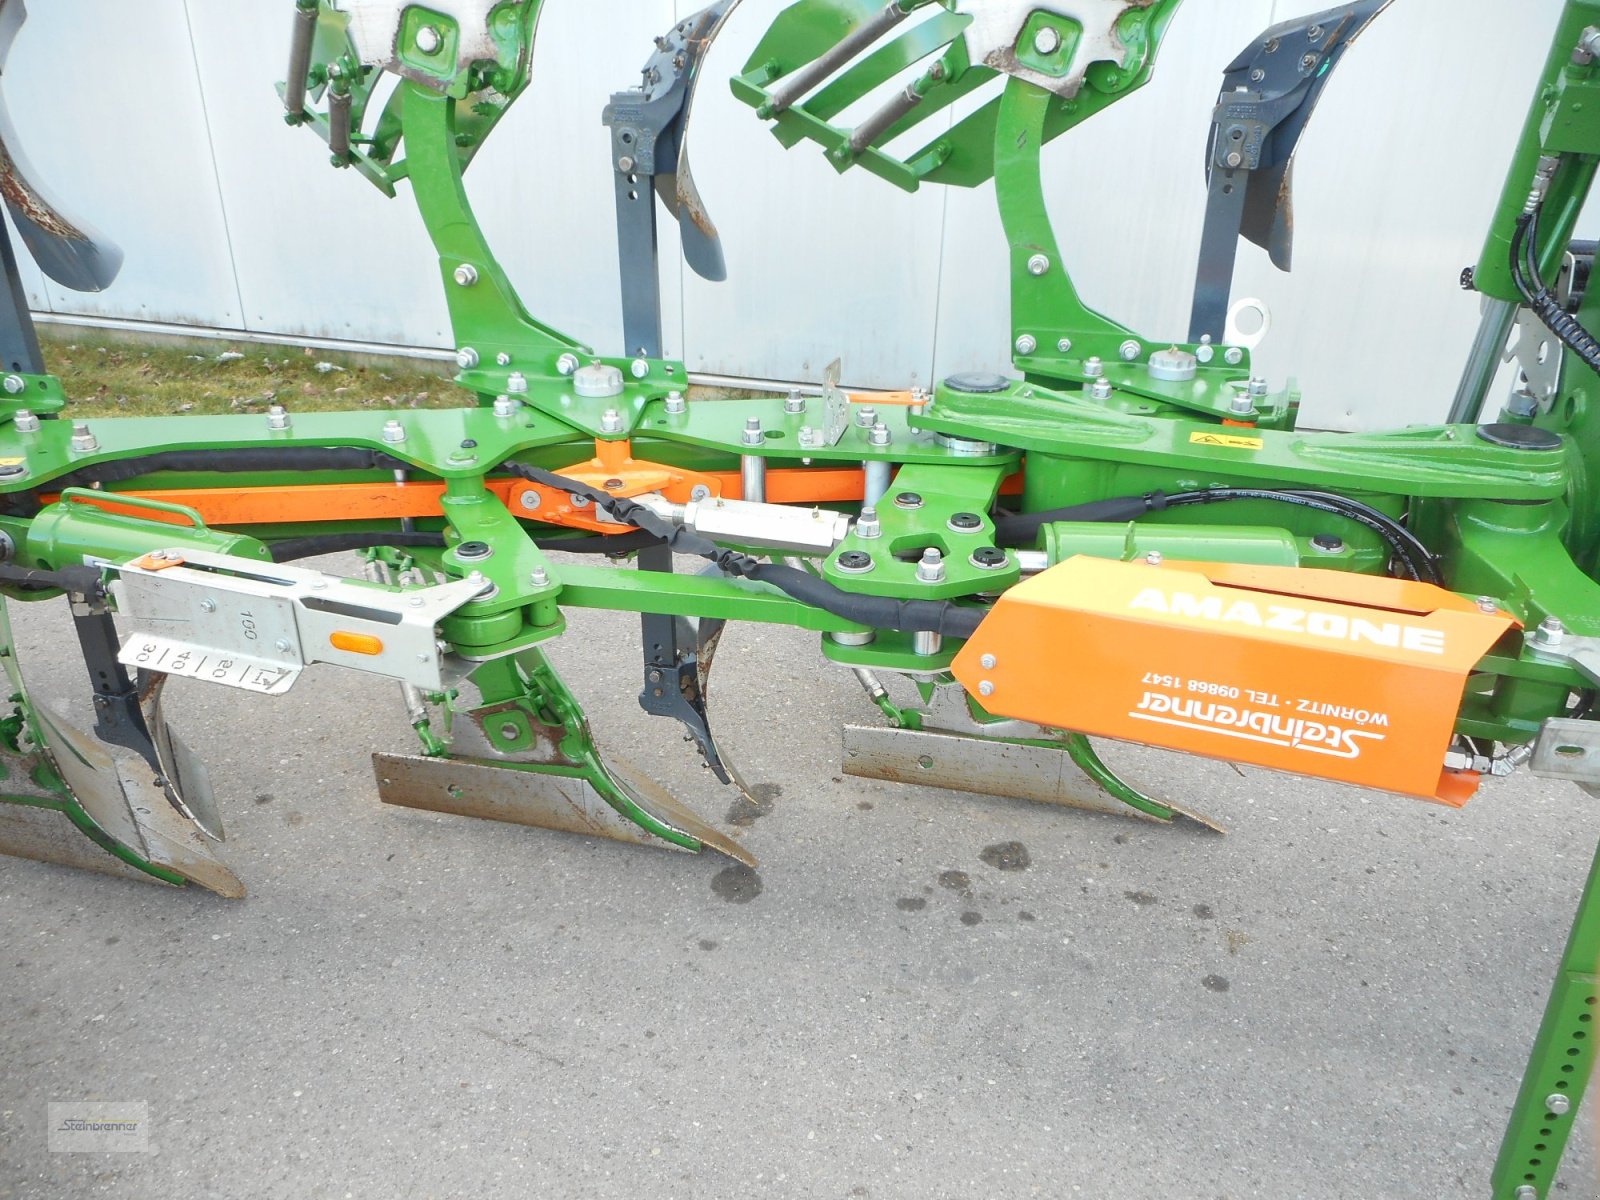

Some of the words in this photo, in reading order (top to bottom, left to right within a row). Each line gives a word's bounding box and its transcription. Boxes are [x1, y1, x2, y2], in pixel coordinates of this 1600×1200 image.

[240, 611, 257, 640] 100
[1129, 588, 1445, 655] AMAZONE
[1141, 672, 1182, 689] 1547
[1187, 679, 1239, 699] 09868
[1244, 689, 1280, 707] TEL
[1128, 691, 1386, 759] Steinbrenner
[1296, 699, 1389, 726] WÖRNITZ
